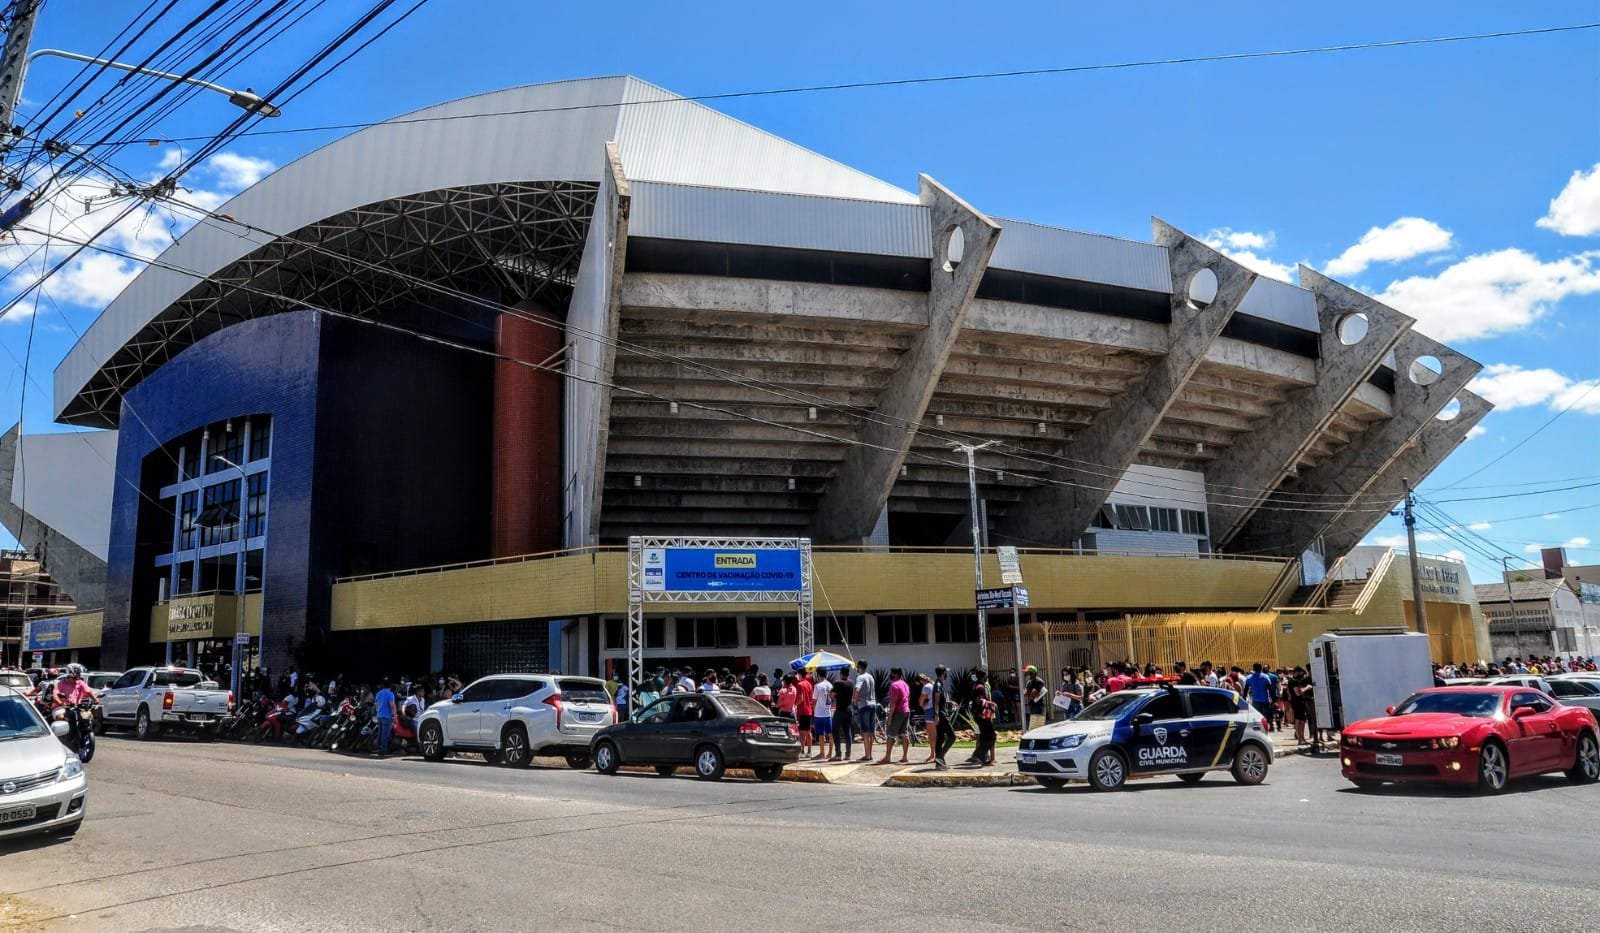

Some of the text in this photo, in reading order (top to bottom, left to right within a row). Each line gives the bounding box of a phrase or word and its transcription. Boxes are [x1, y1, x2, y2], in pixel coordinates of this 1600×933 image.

[716, 556, 754, 565] ENTRADA
[675, 570, 795, 580] CENTRO DE VACINAÇÃO COVID-19
[1138, 746, 1187, 760] GUARDA
[1155, 757, 1187, 765] MUNICIPAL
[11, 807, 34, 820] 0553
